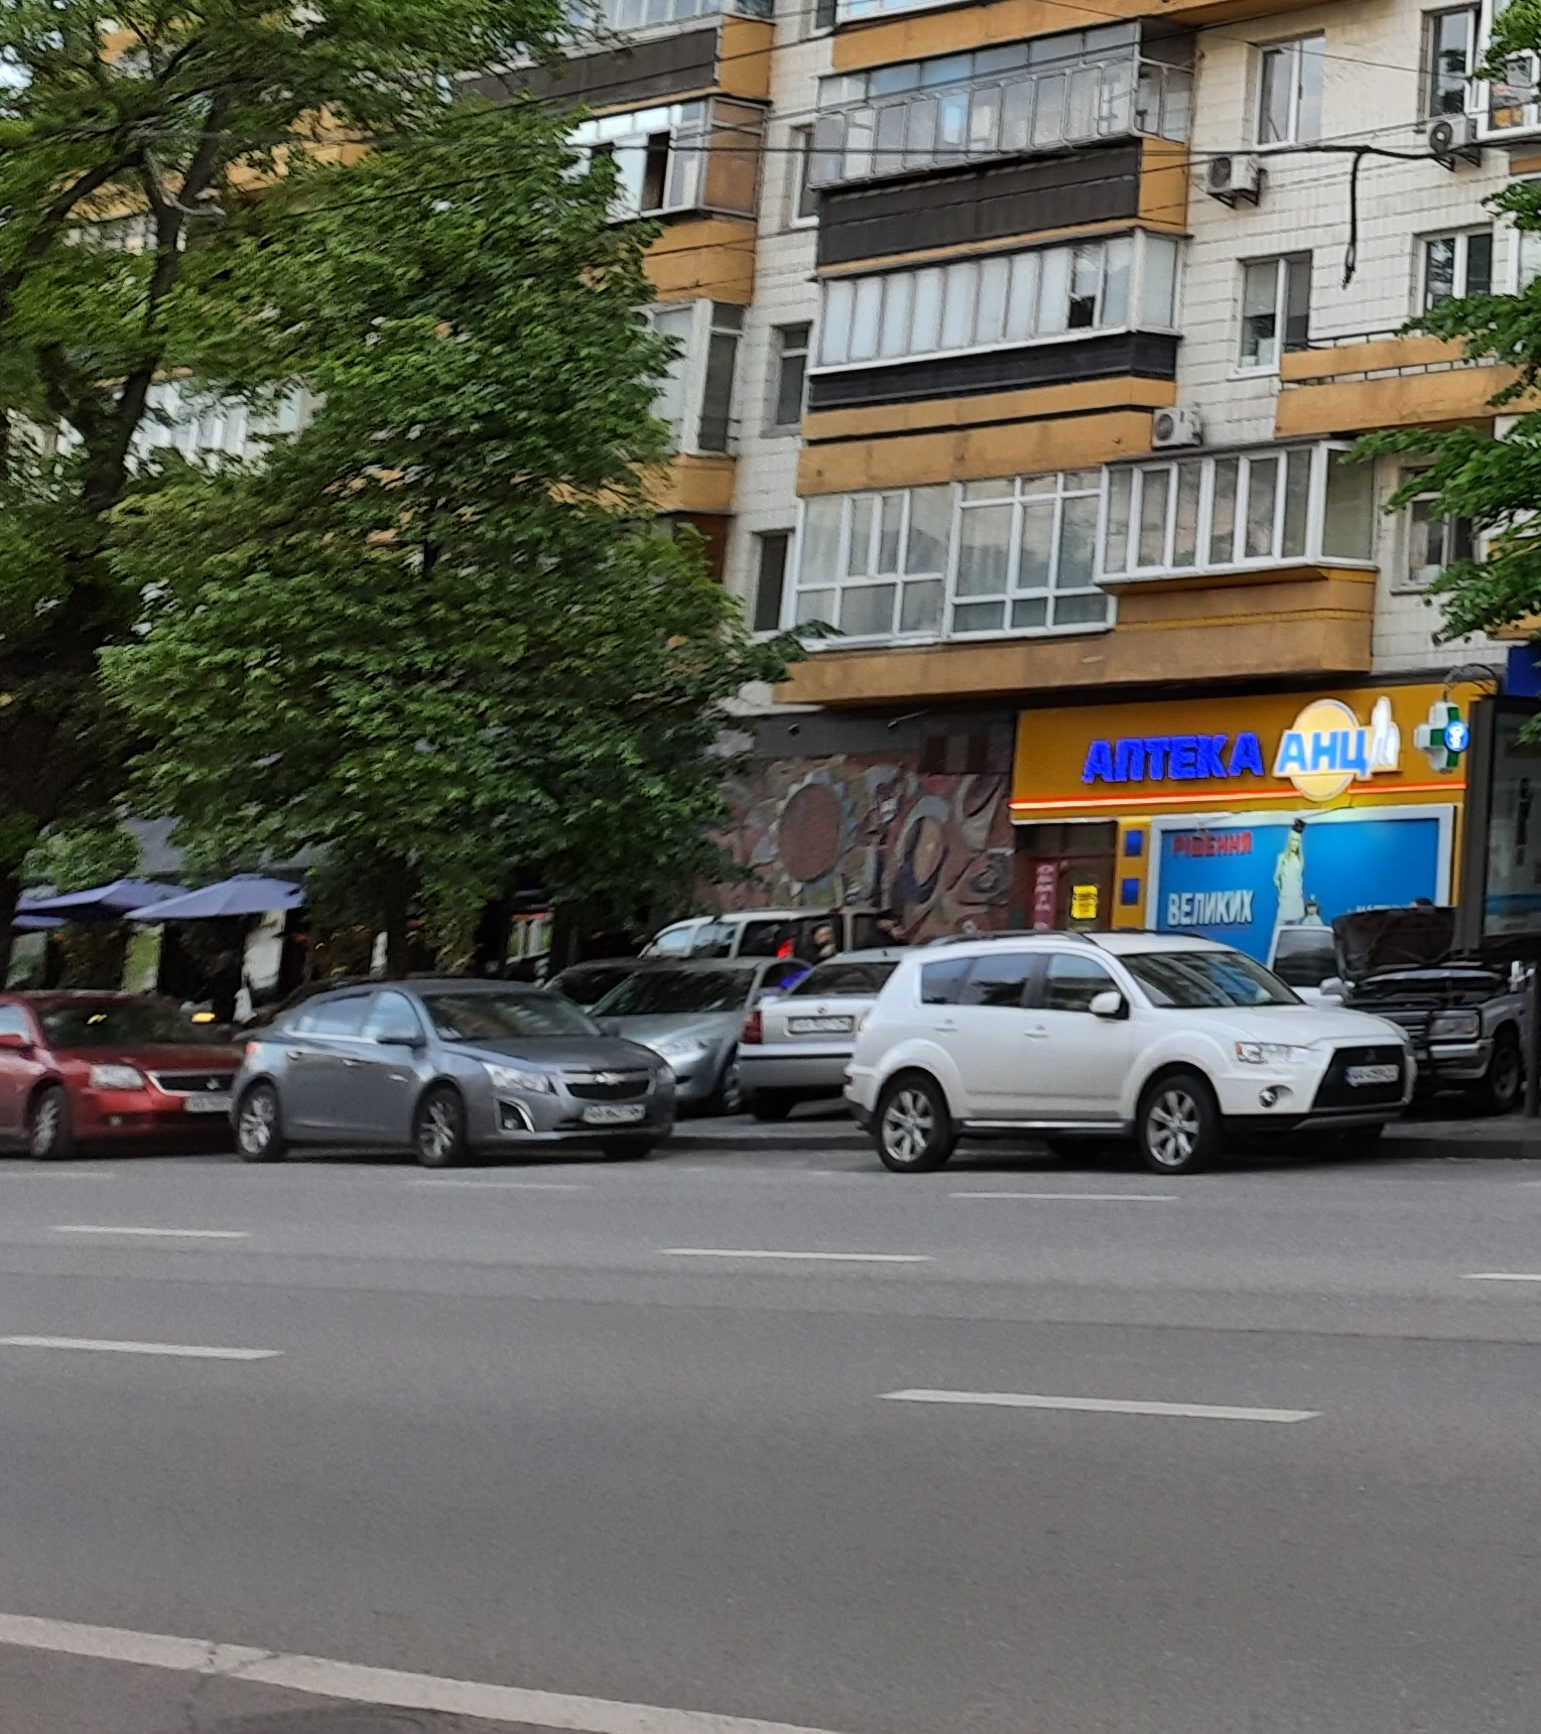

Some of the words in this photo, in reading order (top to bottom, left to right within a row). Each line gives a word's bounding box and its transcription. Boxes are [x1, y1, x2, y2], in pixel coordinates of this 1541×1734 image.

[1081, 732, 1265, 784] АПТЕКА
[1276, 728, 1369, 777] АНЦ
[1167, 889, 1255, 927] ВЕЛИКИХ
